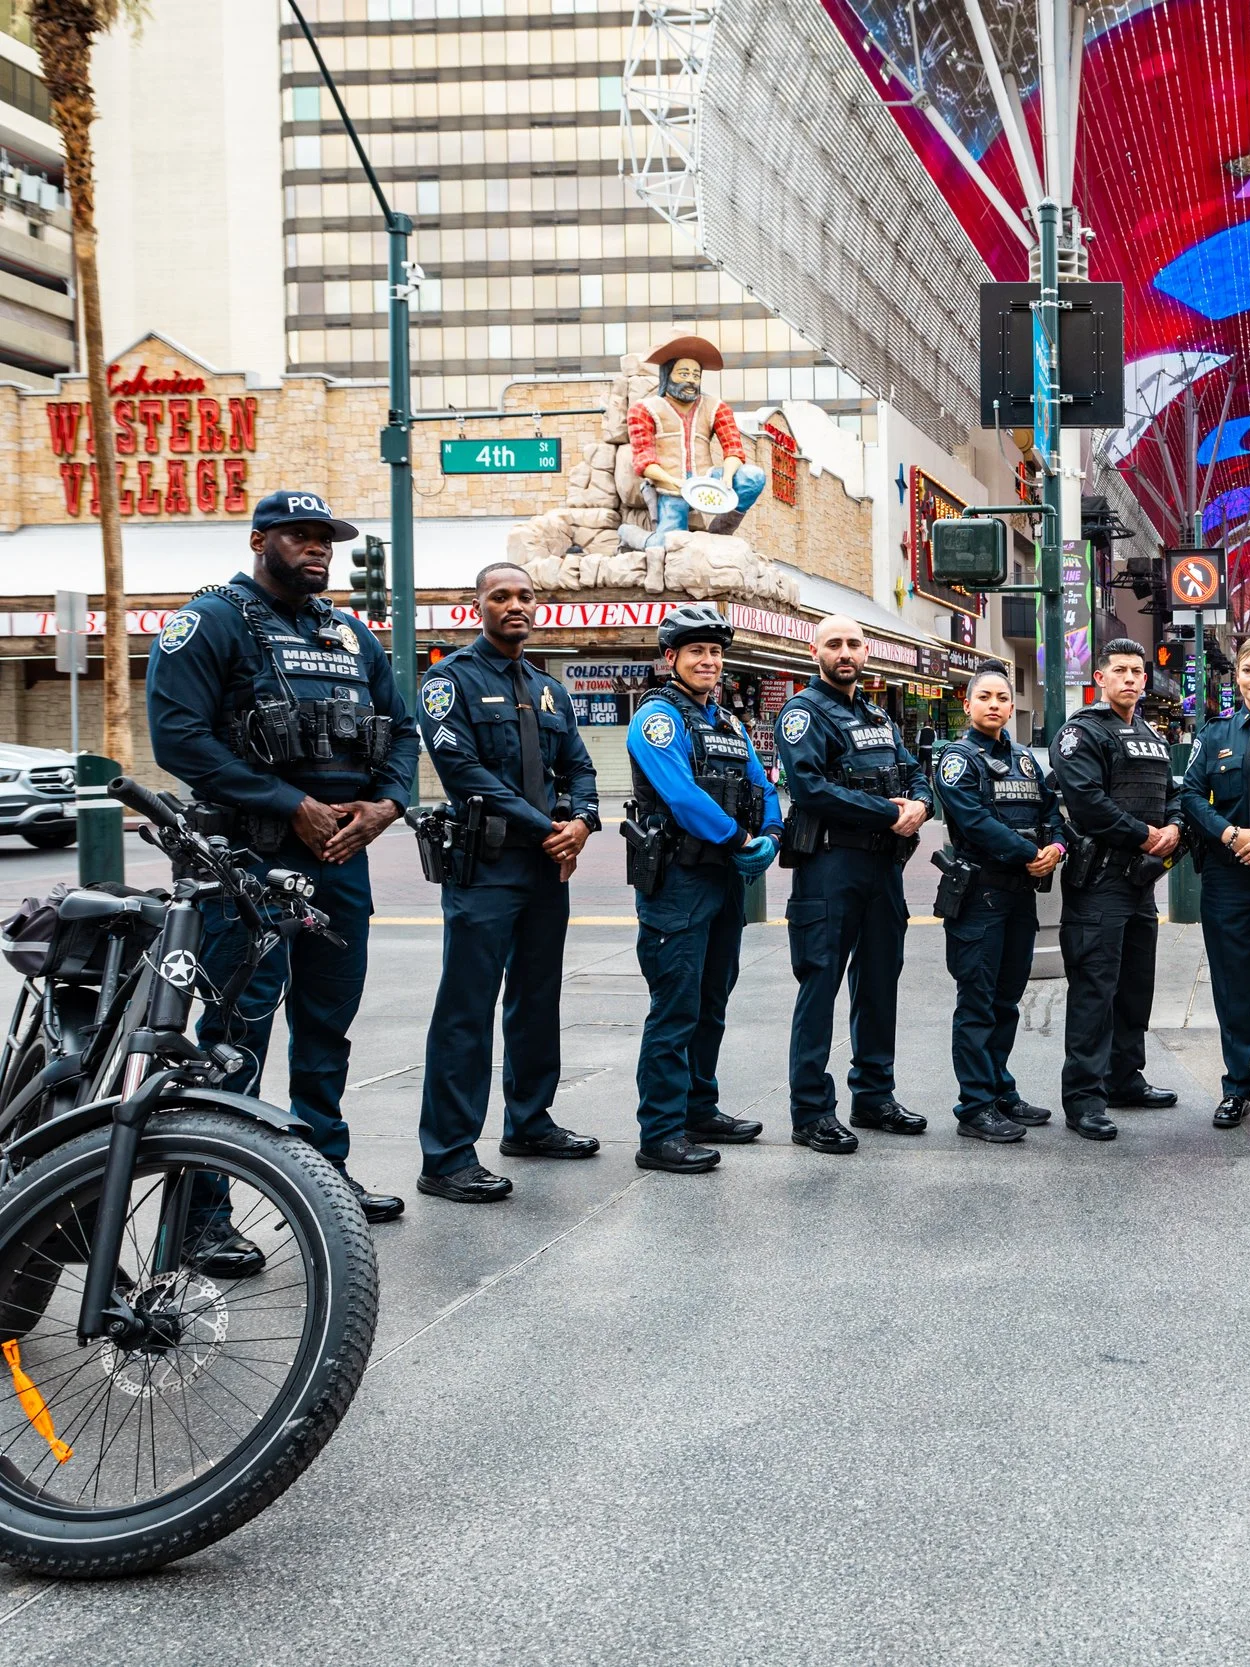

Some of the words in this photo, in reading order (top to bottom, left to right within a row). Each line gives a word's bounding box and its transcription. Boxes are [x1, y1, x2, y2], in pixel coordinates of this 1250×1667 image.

[445, 443, 452, 453] N
[475, 445, 515, 467] 4th
[539, 442, 548, 452] St
[539, 457, 555, 467] 100
[534, 601, 698, 626] OUVENIR
[734, 604, 785, 636] TOBACCO
[864, 637, 899, 662] OUVENIRS
[282, 650, 358, 666] MARSHAL
[284, 660, 360, 677] POLICE
[566, 665, 618, 678] COLDEST
[575, 681, 583, 690] IN
[586, 680, 613, 690] TOWN
[574, 699, 588, 707] UD
[590, 702, 616, 713] BUD
[704, 735, 748, 749] MARSHA
[761, 731, 774, 740] FOR
[856, 737, 896, 747] POLIC
[1126, 741, 1170, 759] S.E.R.T.
[994, 781, 1040, 793] MARSHAL
